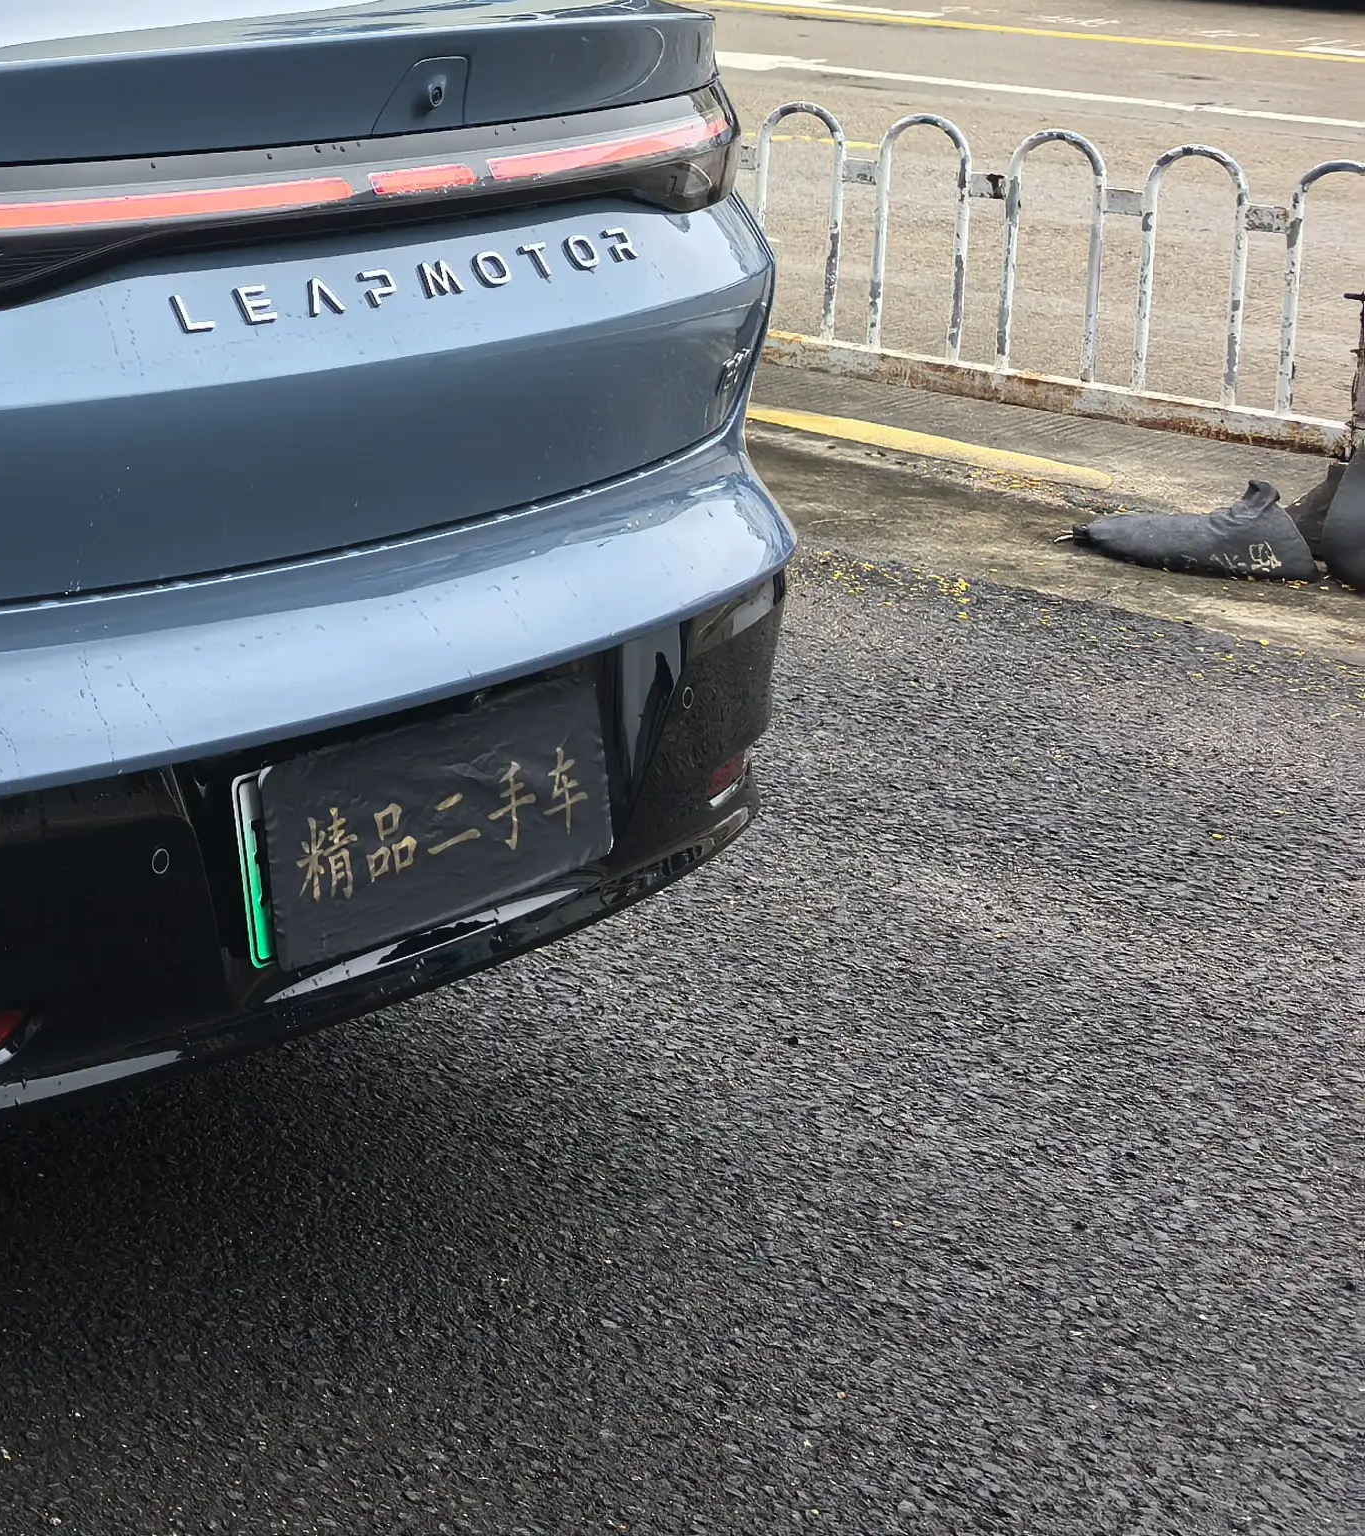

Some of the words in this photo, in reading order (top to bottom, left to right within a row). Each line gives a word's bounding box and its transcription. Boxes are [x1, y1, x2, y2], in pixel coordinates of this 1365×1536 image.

[169, 226, 640, 334] LEAPMOTOR
[296, 746, 589, 903] 精品二手车
